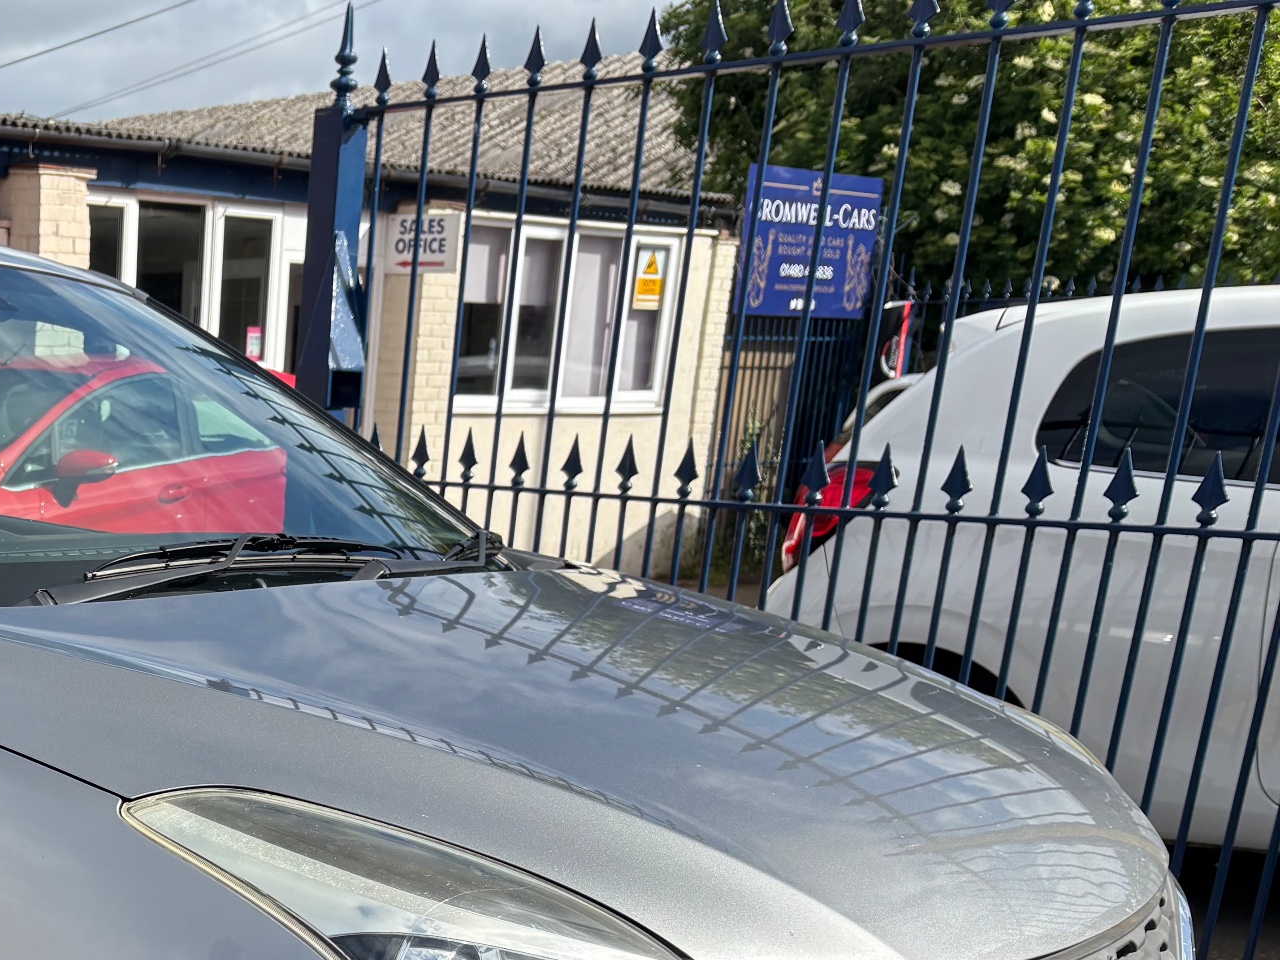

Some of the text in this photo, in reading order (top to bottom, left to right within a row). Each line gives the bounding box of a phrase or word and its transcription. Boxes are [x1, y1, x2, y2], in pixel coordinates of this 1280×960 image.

[749, 198, 877, 231] ROMWEL-CARS
[399, 218, 445, 235] SAES
[827, 236, 845, 248] CARS
[804, 266, 834, 280] 4836
